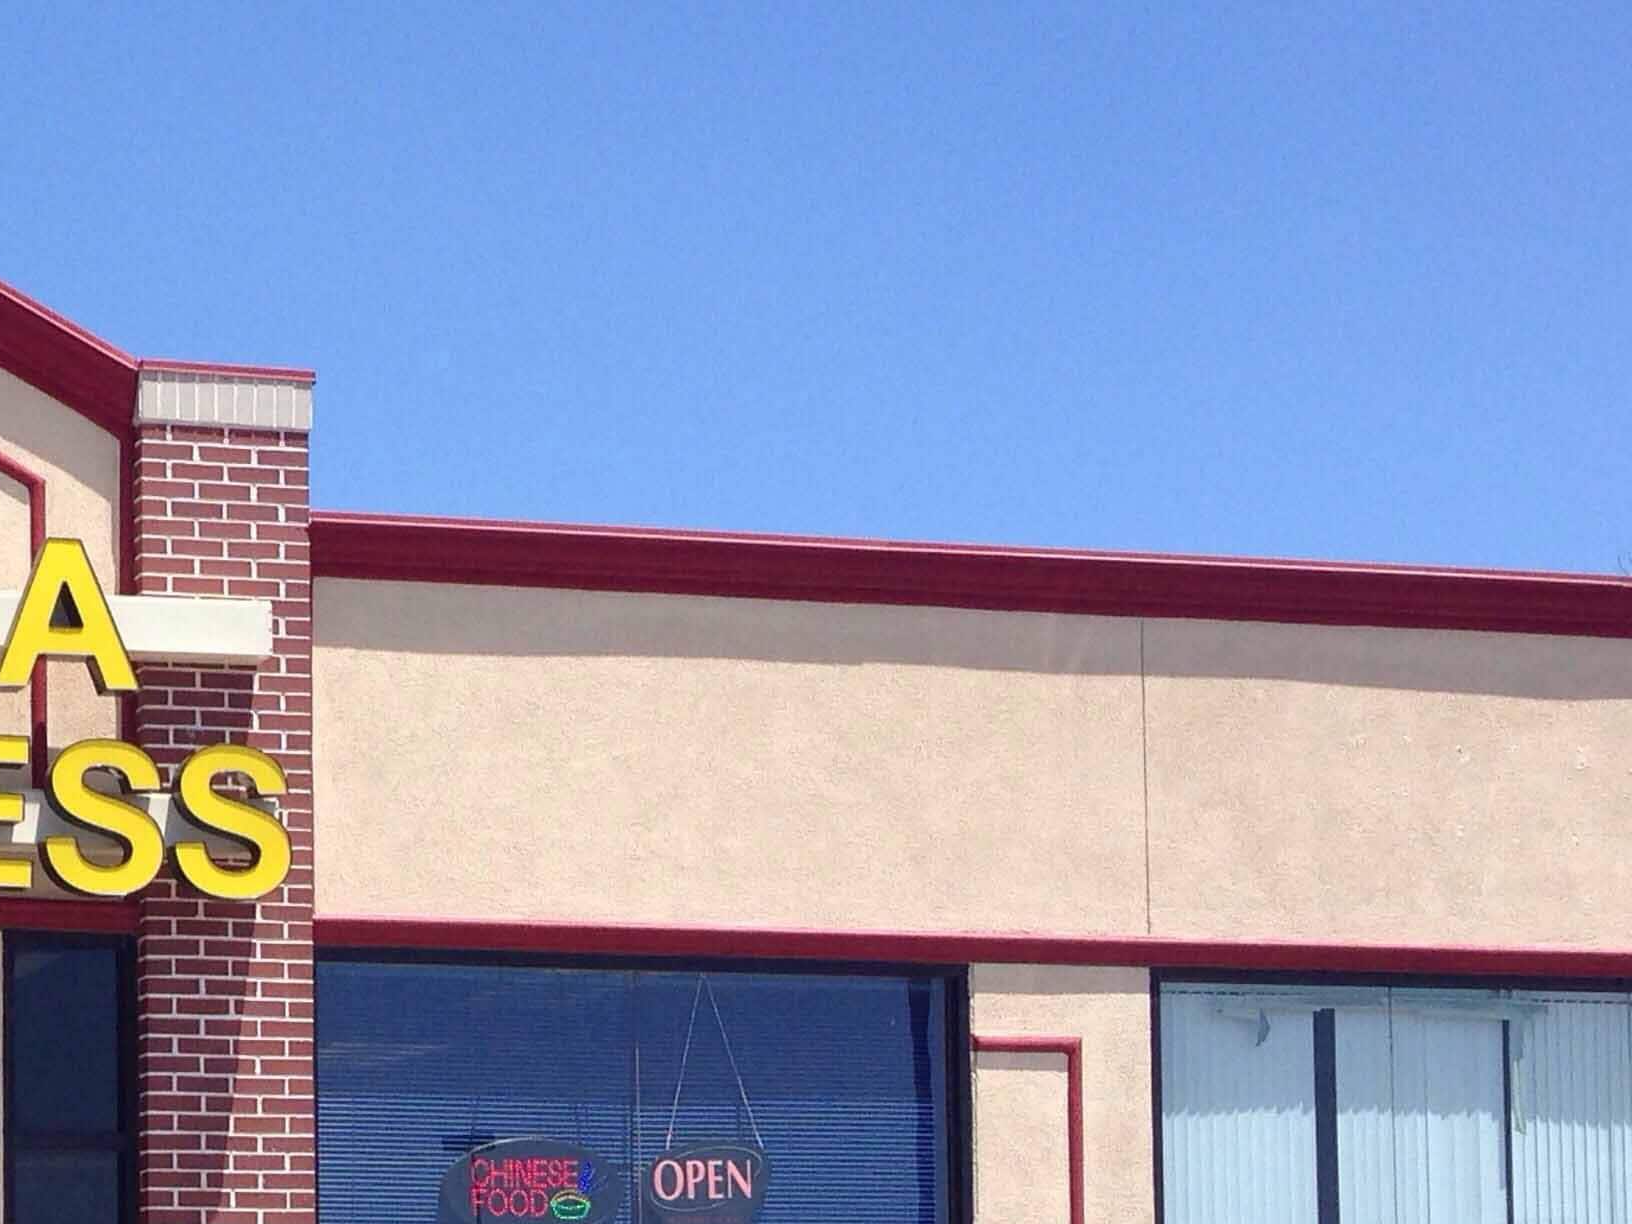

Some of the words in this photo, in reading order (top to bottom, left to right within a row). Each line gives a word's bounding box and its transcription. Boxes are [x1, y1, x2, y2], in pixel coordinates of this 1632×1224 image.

[470, 1157, 580, 1189] CHINESE
[654, 1159, 752, 1200] OPEN
[471, 1187, 549, 1217] FOOD
